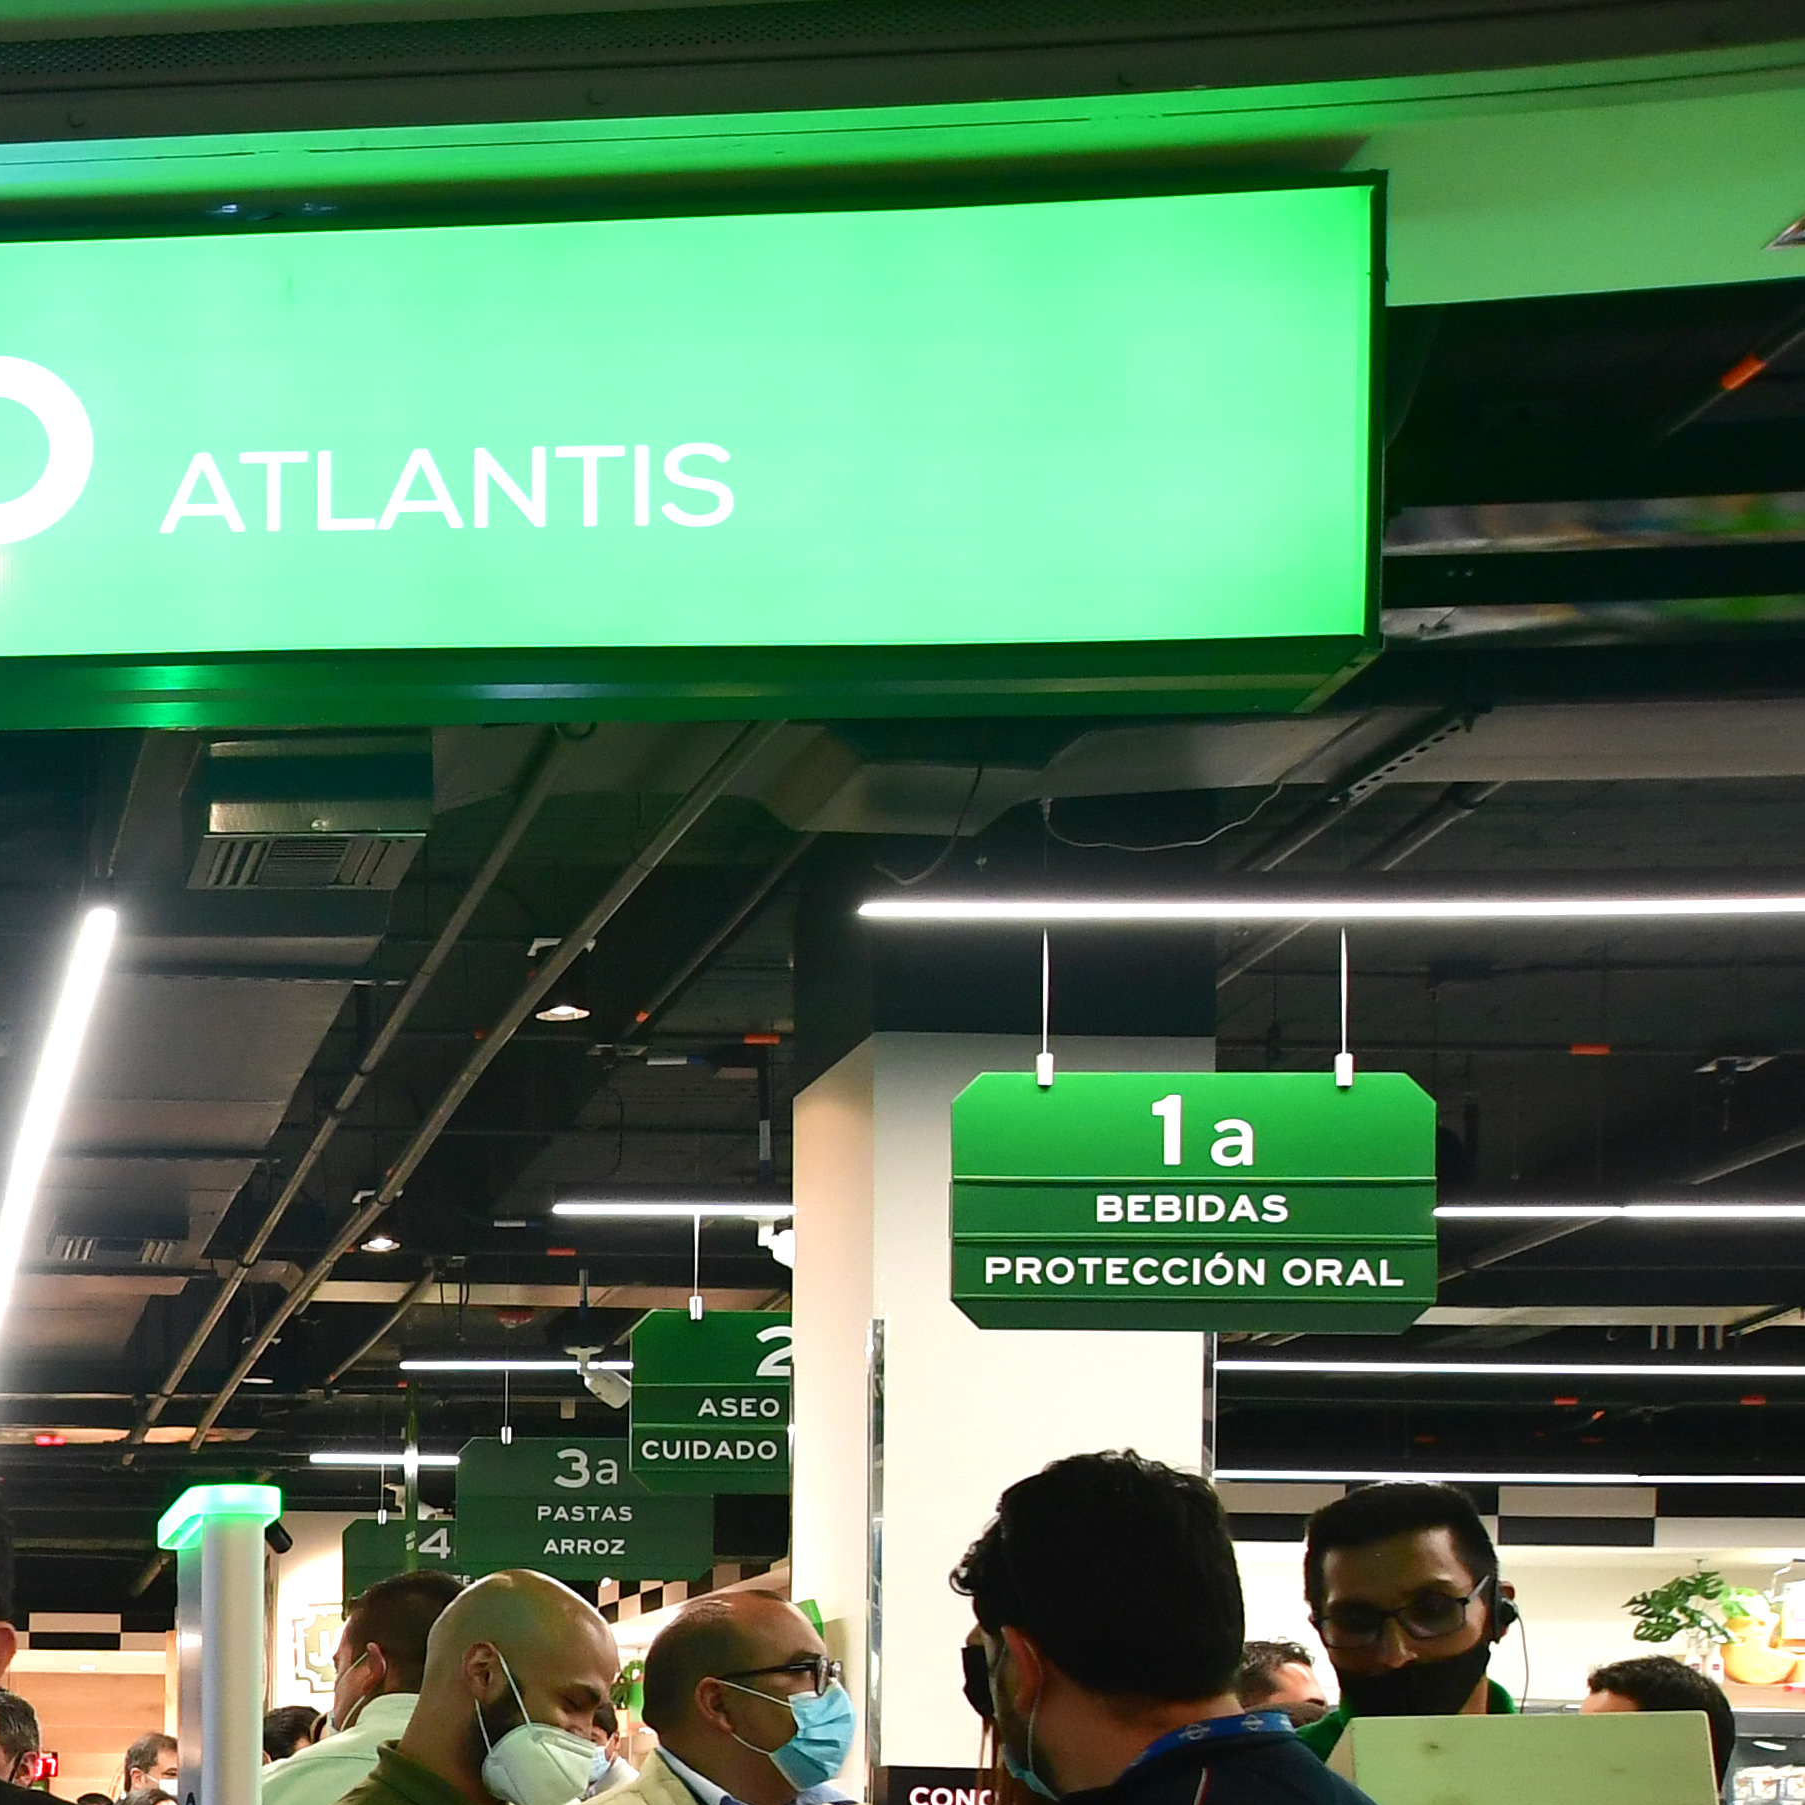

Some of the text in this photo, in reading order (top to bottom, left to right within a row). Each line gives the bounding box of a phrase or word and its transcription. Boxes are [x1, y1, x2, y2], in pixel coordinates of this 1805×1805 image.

[159, 442, 734, 534] ATLANTIS
[1095, 1194, 1289, 1223] BEBIDAS
[984, 1252, 1405, 1287] PROTECCIÓN ORAL
[697, 1397, 780, 1418] ASEO
[641, 1439, 778, 1460] CUIDADO
[554, 1448, 618, 1488] 3a
[537, 1505, 632, 1522] PASTAS
[543, 1539, 626, 1555] ARROZ
